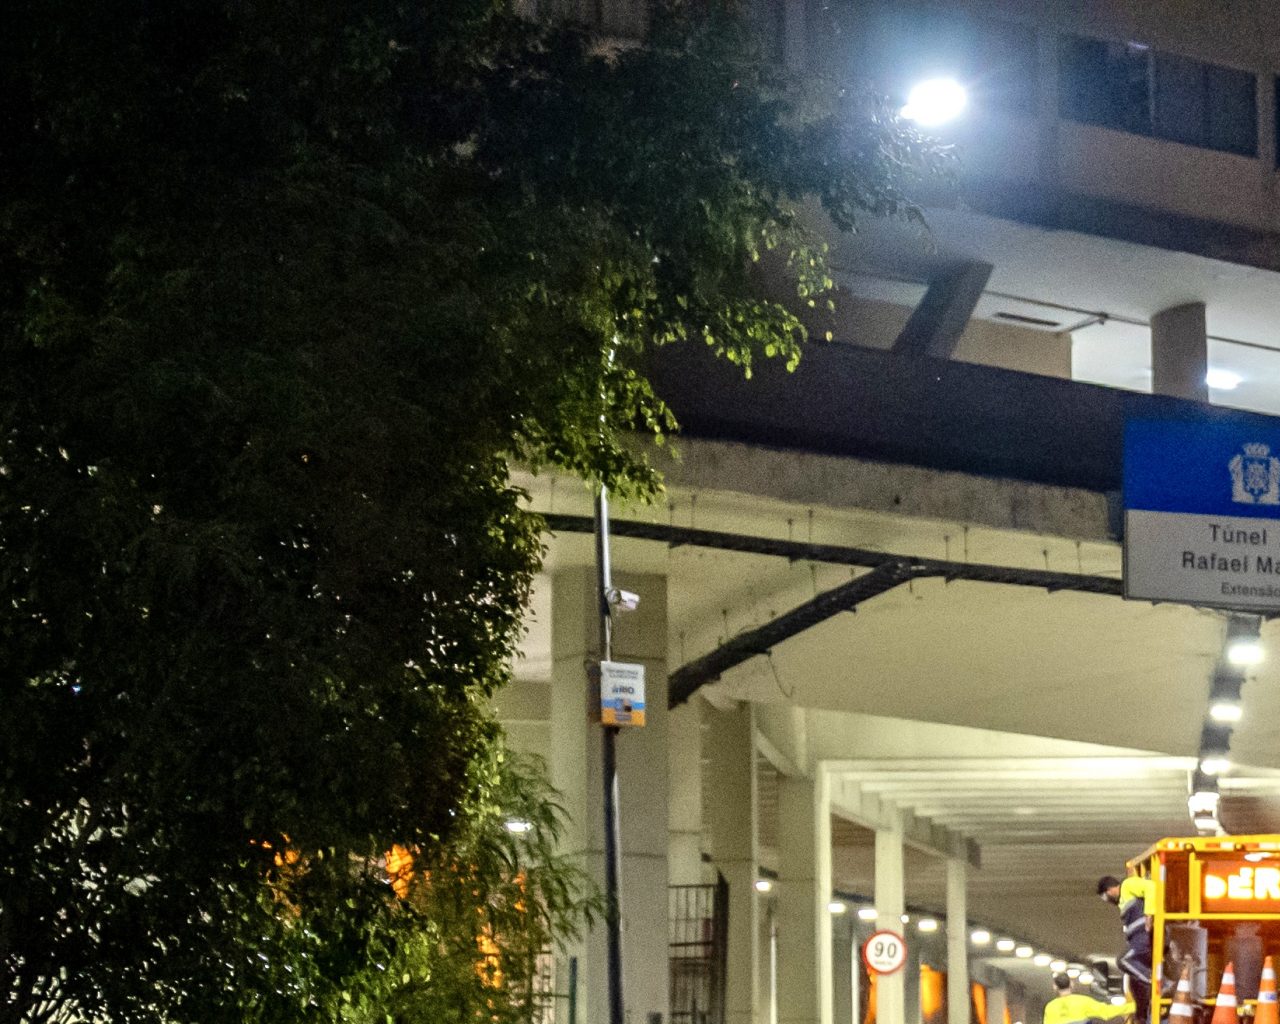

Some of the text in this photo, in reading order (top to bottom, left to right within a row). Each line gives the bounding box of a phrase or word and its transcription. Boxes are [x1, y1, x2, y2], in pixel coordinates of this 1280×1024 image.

[1208, 523, 1268, 546] Túnel
[1181, 550, 1248, 573] Rafael
[874, 940, 897, 959] 90
